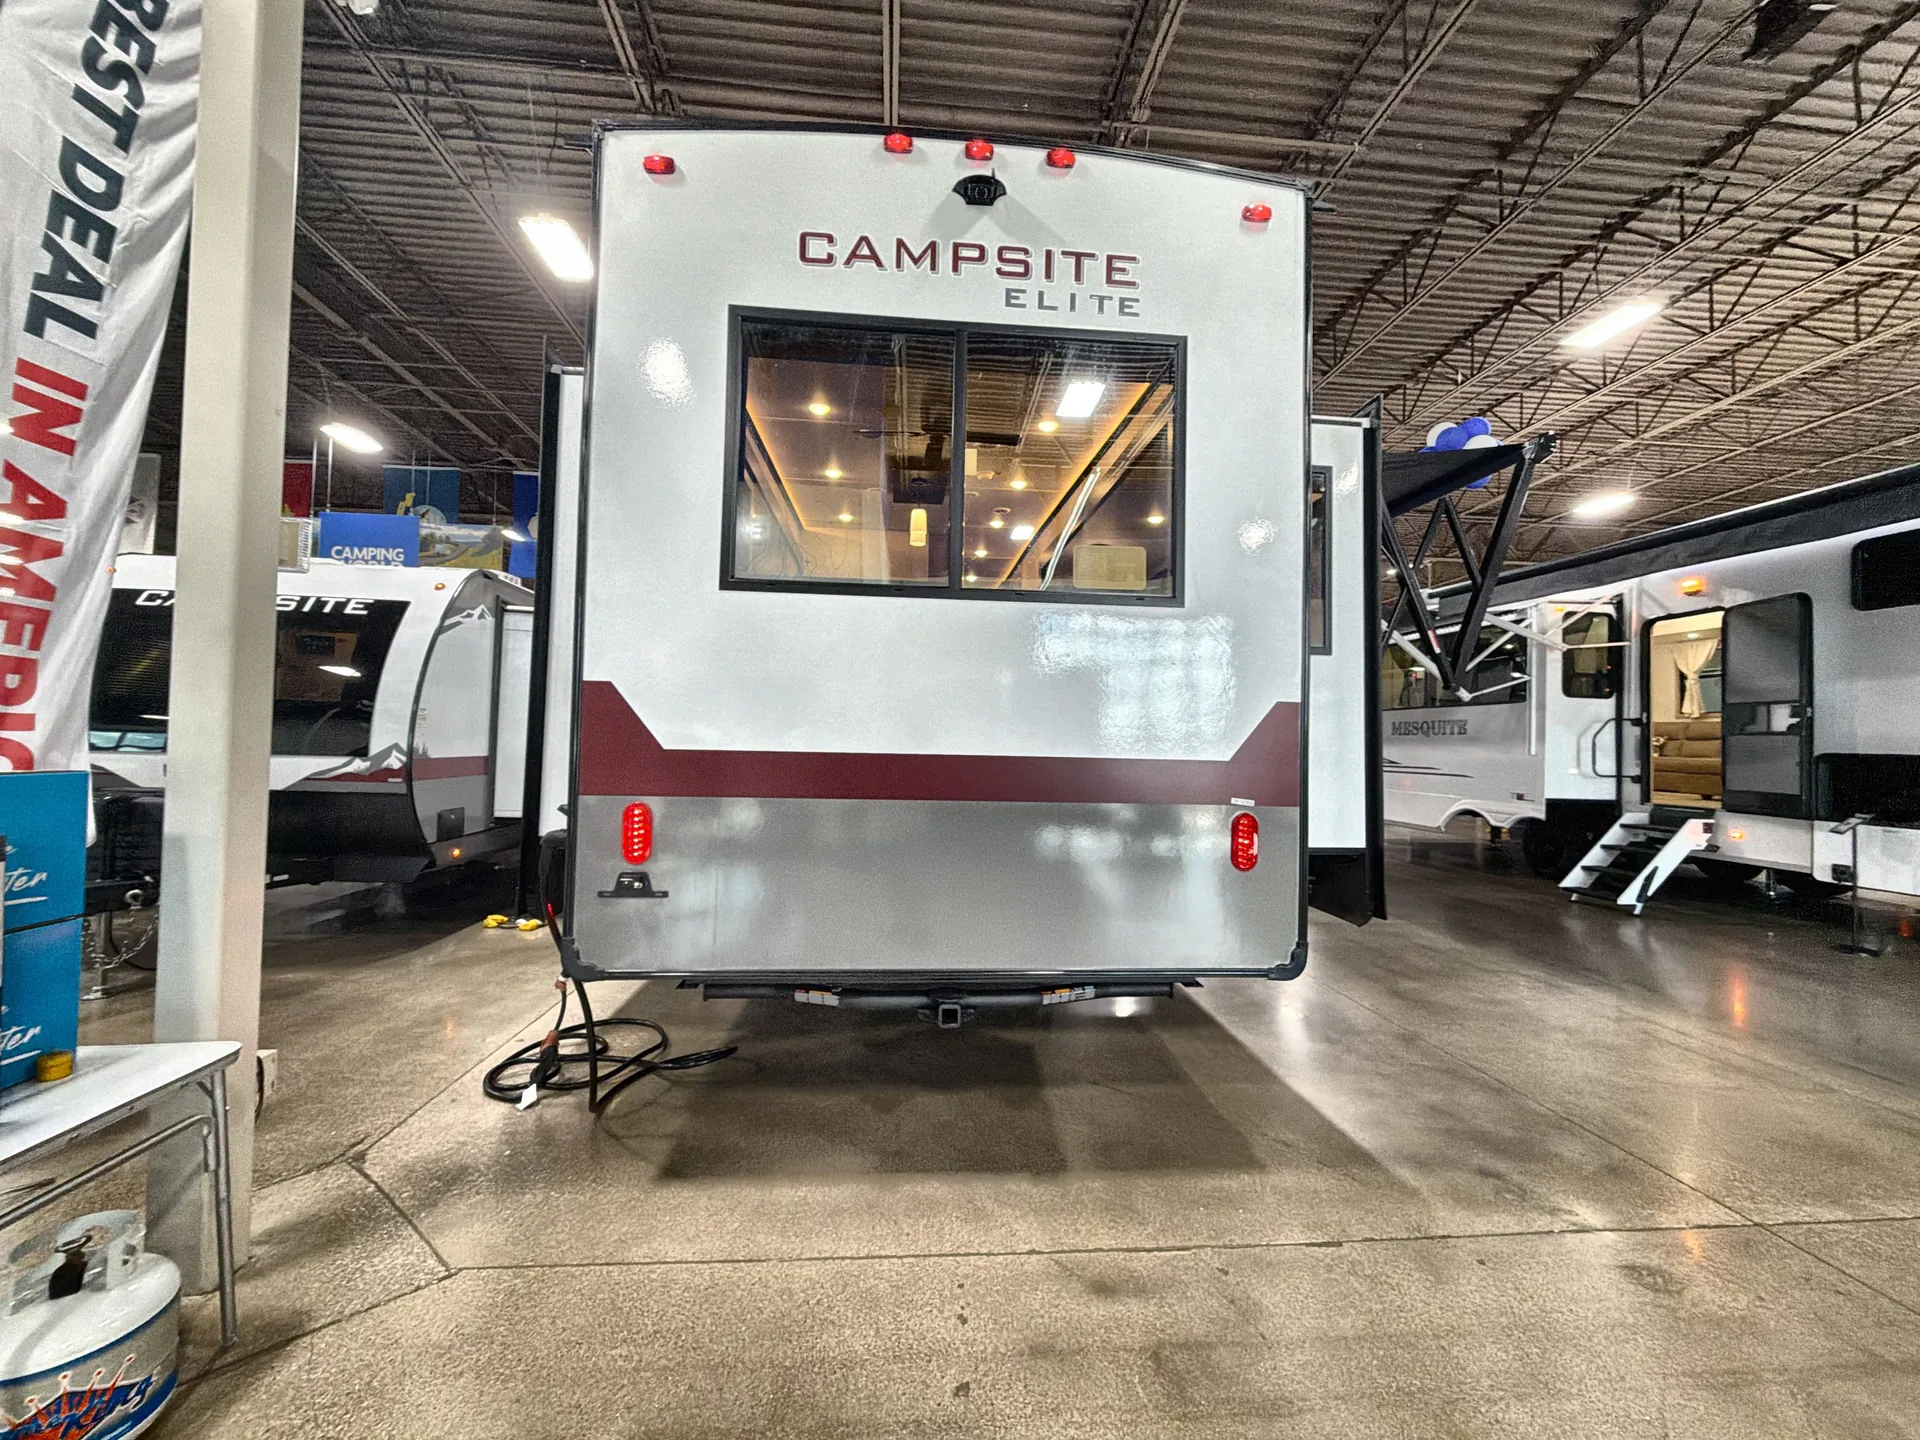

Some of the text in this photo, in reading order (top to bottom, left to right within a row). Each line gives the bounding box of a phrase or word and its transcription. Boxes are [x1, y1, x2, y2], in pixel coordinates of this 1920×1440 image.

[23, 135, 125, 341] DEAL
[798, 231, 1141, 290] CAMPSITE
[1004, 287, 1141, 318] ELITE
[8, 357, 89, 457] IN
[331, 545, 405, 562] CAMPING
[134, 590, 374, 615] CSITE
[1391, 719, 1468, 738] MESQUITE
